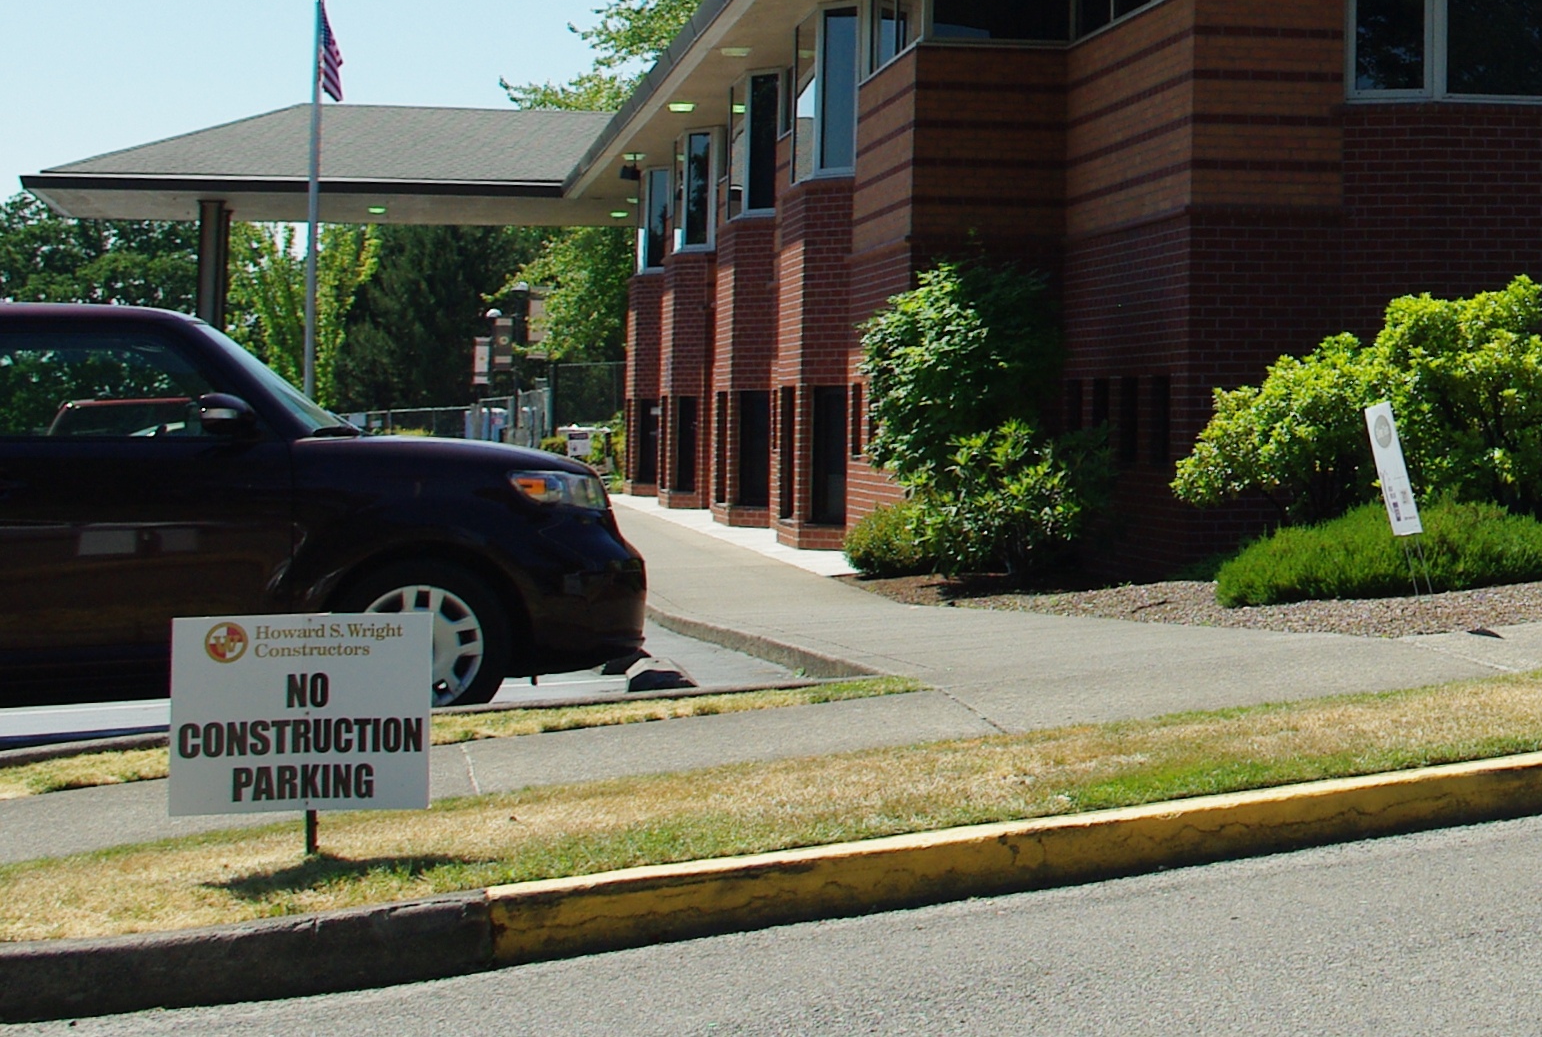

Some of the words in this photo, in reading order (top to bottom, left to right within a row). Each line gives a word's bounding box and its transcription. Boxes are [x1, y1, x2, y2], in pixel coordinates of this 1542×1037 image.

[255, 624, 326, 640] Howard
[330, 624, 345, 638] S.
[348, 623, 403, 639] Wright
[254, 644, 370, 657] Constructors
[286, 673, 330, 708] NO
[178, 718, 423, 759] CONSTRUCTION
[232, 763, 375, 802] PARKING
